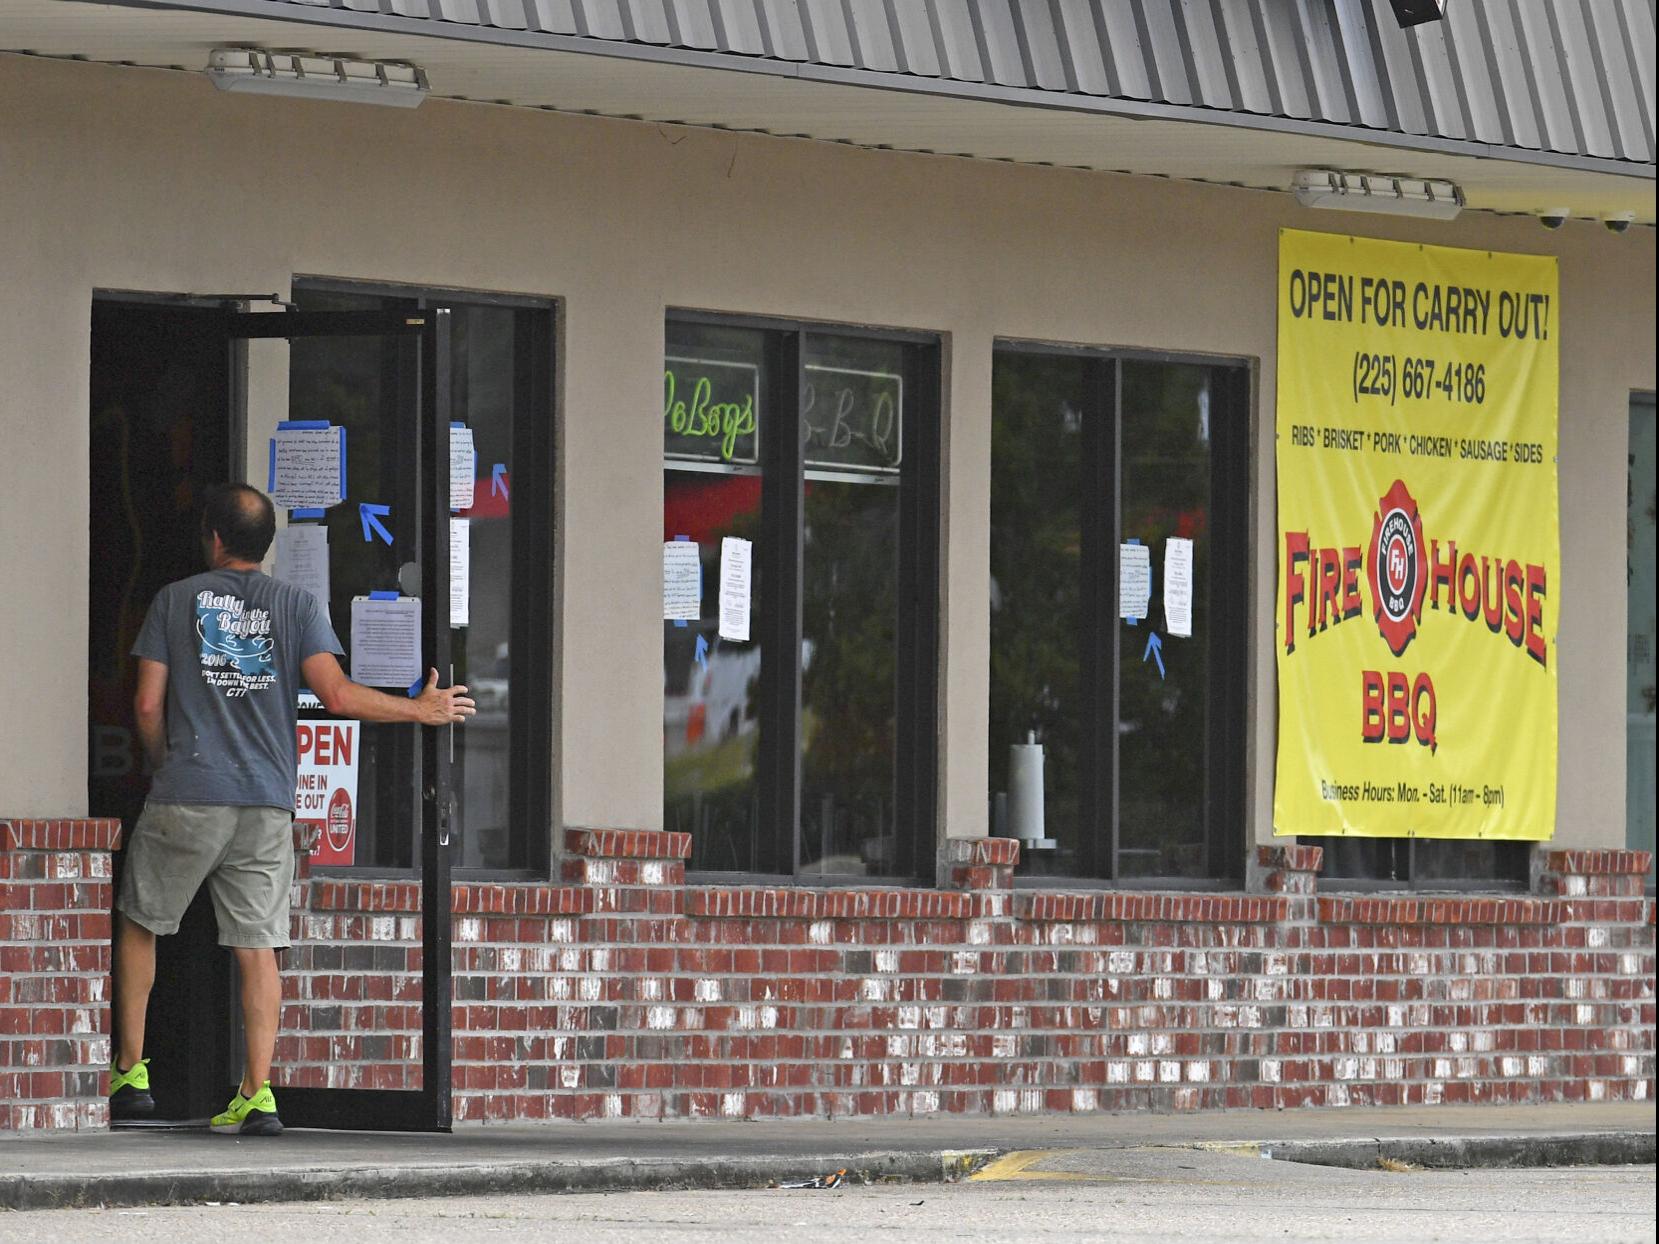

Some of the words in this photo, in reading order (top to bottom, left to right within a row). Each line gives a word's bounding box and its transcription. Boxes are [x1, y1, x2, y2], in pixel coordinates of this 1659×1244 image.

[1290, 269, 1353, 322] OPEN
[1361, 277, 1406, 328] FOR
[1413, 282, 1491, 335] CARRY
[1500, 291, 1549, 341] OUT!
[1353, 352, 1397, 406] (225)
[1403, 357, 1486, 404] 667-4186
[1292, 425, 1315, 447] RIBS
[1323, 428, 1364, 450] BRISKET
[1374, 432, 1401, 454] PORK
[1409, 435, 1451, 457] CHICKEN
[1460, 440, 1508, 462] SAUSAGE
[1514, 443, 1543, 464] SIDES
[1381, 517, 1414, 556] FIREHOUSE
[1390, 549, 1405, 580] FH
[197, 590, 245, 618] Rally
[251, 608, 269, 621] the
[1285, 528, 1363, 656] FIRE
[1430, 539, 1547, 672] HOUSE
[1389, 596, 1405, 612] BBQ
[217, 611, 271, 639] Bayou
[1362, 670, 1437, 757] BBQ
[296, 725, 353, 766] PEN
[297, 774, 315, 790] INE
[318, 775, 328, 790] IN
[1321, 779, 1360, 802] Business
[1362, 781, 1395, 802] Hours:
[304, 794, 326, 810] OUT
